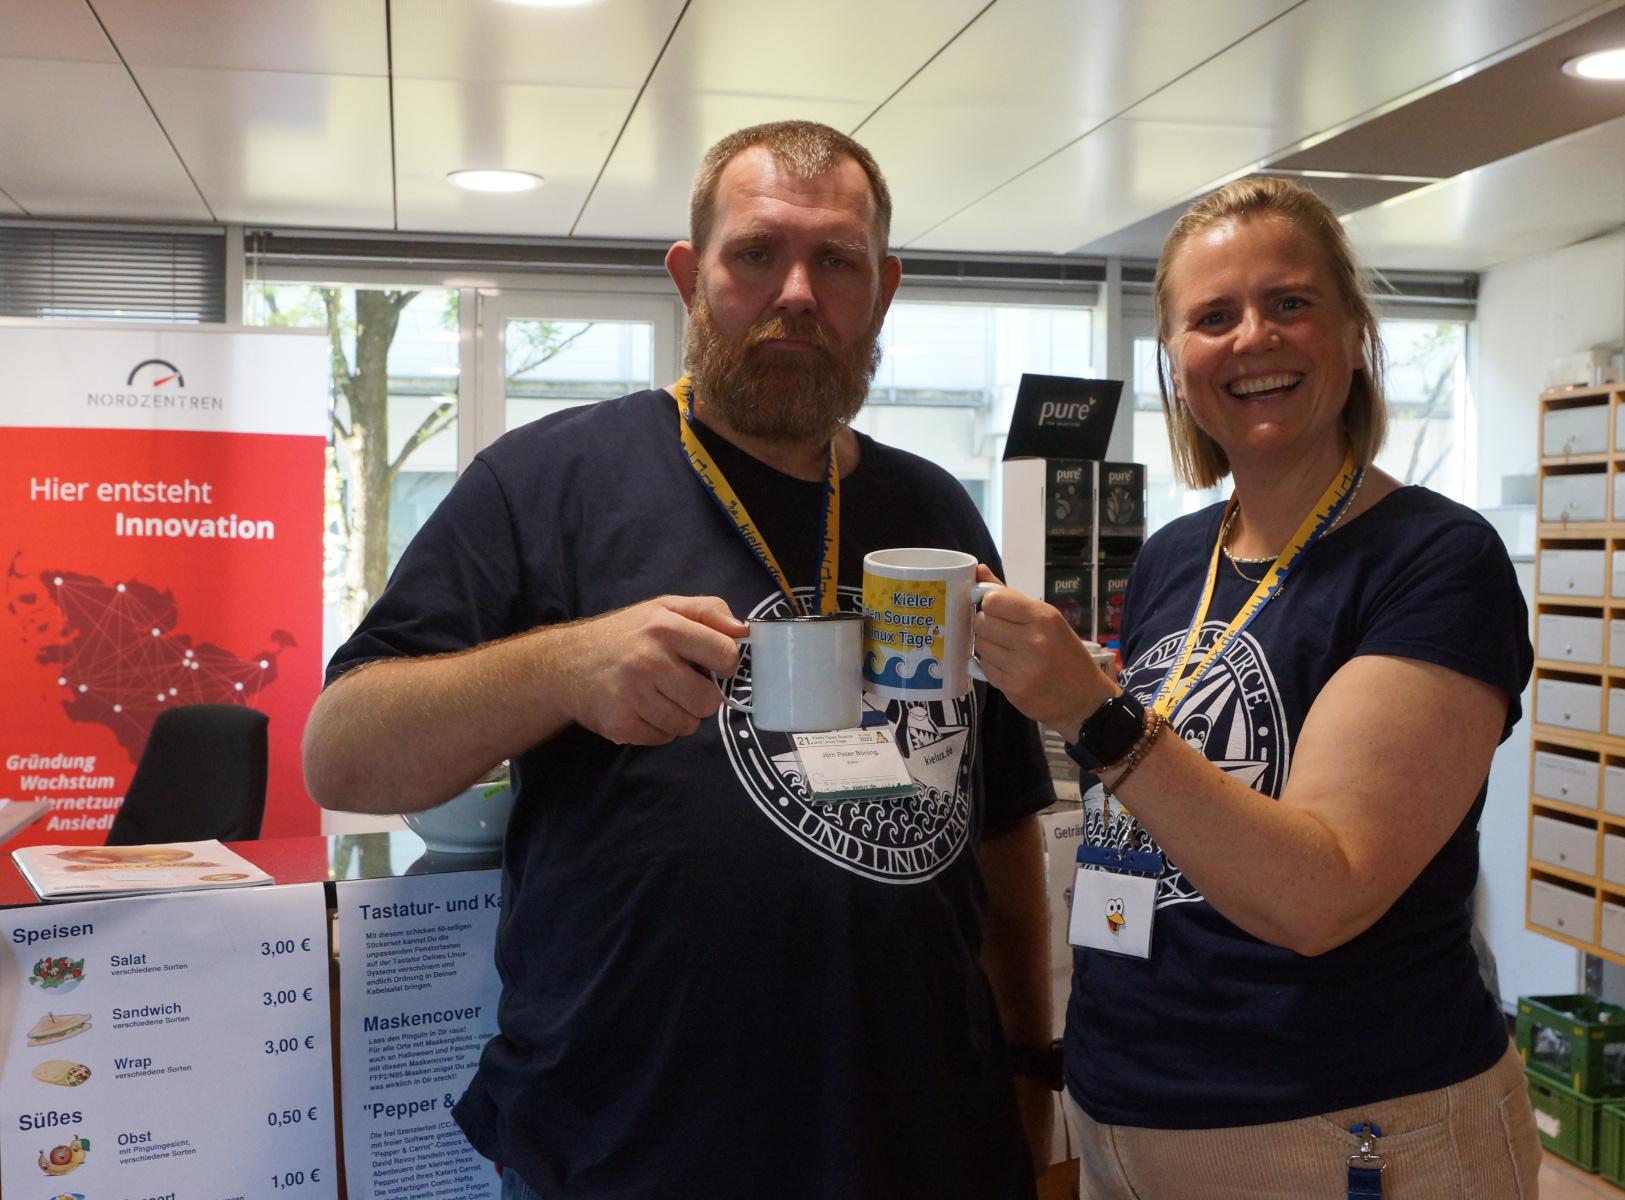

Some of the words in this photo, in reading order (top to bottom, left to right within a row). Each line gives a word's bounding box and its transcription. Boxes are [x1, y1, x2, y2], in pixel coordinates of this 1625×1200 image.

[88, 393, 222, 409] NORDZENTREN
[1038, 402, 1090, 426] pure
[1057, 469, 1080, 482] pure
[1109, 472, 1131, 484] pure
[31, 478, 89, 501] Hier
[97, 479, 212, 503] entsteht
[116, 513, 274, 539] Innovation
[1055, 578, 1078, 592] pure
[1108, 579, 1128, 592] pur
[893, 593, 934, 608] Kieler
[884, 610, 933, 626] Source
[872, 628, 895, 642] inux
[899, 632, 933, 648] Tage
[1186, 629, 1236, 690] kielux.de
[6, 753, 96, 773] Gründung
[20, 774, 115, 790] Wachstum
[798, 807, 862, 862] UND
[872, 837, 946, 873] LINUX
[1054, 826, 1084, 840] Geträ
[360, 902, 440, 920] Tastatur-
[447, 895, 478, 912] und
[13, 922, 94, 945] Speisen
[406, 928, 436, 936] schicken
[366, 940, 401, 948] Stickerset
[110, 953, 146, 967] Salat
[262, 940, 295, 956] 3,00
[300, 938, 310, 952] €
[366, 948, 412, 958] unpassenden
[111, 965, 162, 976] verschiedene
[163, 963, 188, 972] Sorten
[366, 968, 396, 977] Systems
[366, 978, 392, 986] endlich
[394, 974, 424, 983] Ordnung
[367, 986, 402, 995] Kabelsalat
[404, 982, 432, 991] bringen.
[112, 1002, 182, 1020] Sandwich
[263, 990, 297, 1006] 3,00
[302, 988, 312, 1002] €
[113, 1018, 164, 1030] verschiedene
[165, 1015, 190, 1024] Sorten
[364, 1006, 482, 1032] Maskencover
[402, 1032, 428, 1042] Pinguin
[114, 1056, 152, 1072] Wrap
[265, 1038, 298, 1054] 3,00
[304, 1036, 314, 1050] €
[369, 1055, 386, 1063] auch
[115, 1068, 164, 1079] verschiedene
[166, 1064, 192, 1074] Sorten
[382, 1062, 407, 1070] diesem
[434, 1065, 454, 1074] zeigst
[386, 1080, 412, 1088] wirklich
[364, 1098, 437, 1118] "Pepper
[444, 1093, 456, 1108] &
[19, 1110, 82, 1130] Süßes
[118, 1131, 152, 1146] Obst
[268, 1109, 301, 1126] 0,50
[307, 1107, 317, 1120] €
[404, 1134, 435, 1144] Software
[119, 1146, 132, 1154] mit
[120, 1154, 170, 1164] verschiedene
[172, 1148, 196, 1157] Sorten
[372, 1160, 392, 1168] David
[418, 1151, 445, 1160] handeln
[272, 1170, 304, 1188] 1,00
[310, 1169, 320, 1182] €
[373, 1166, 414, 1176] Abenteuern
[374, 1178, 398, 1188] Pepper
[400, 1175, 414, 1183] und
[436, 1168, 458, 1177] Katers
[388, 1182, 429, 1194] vollfarbigen
